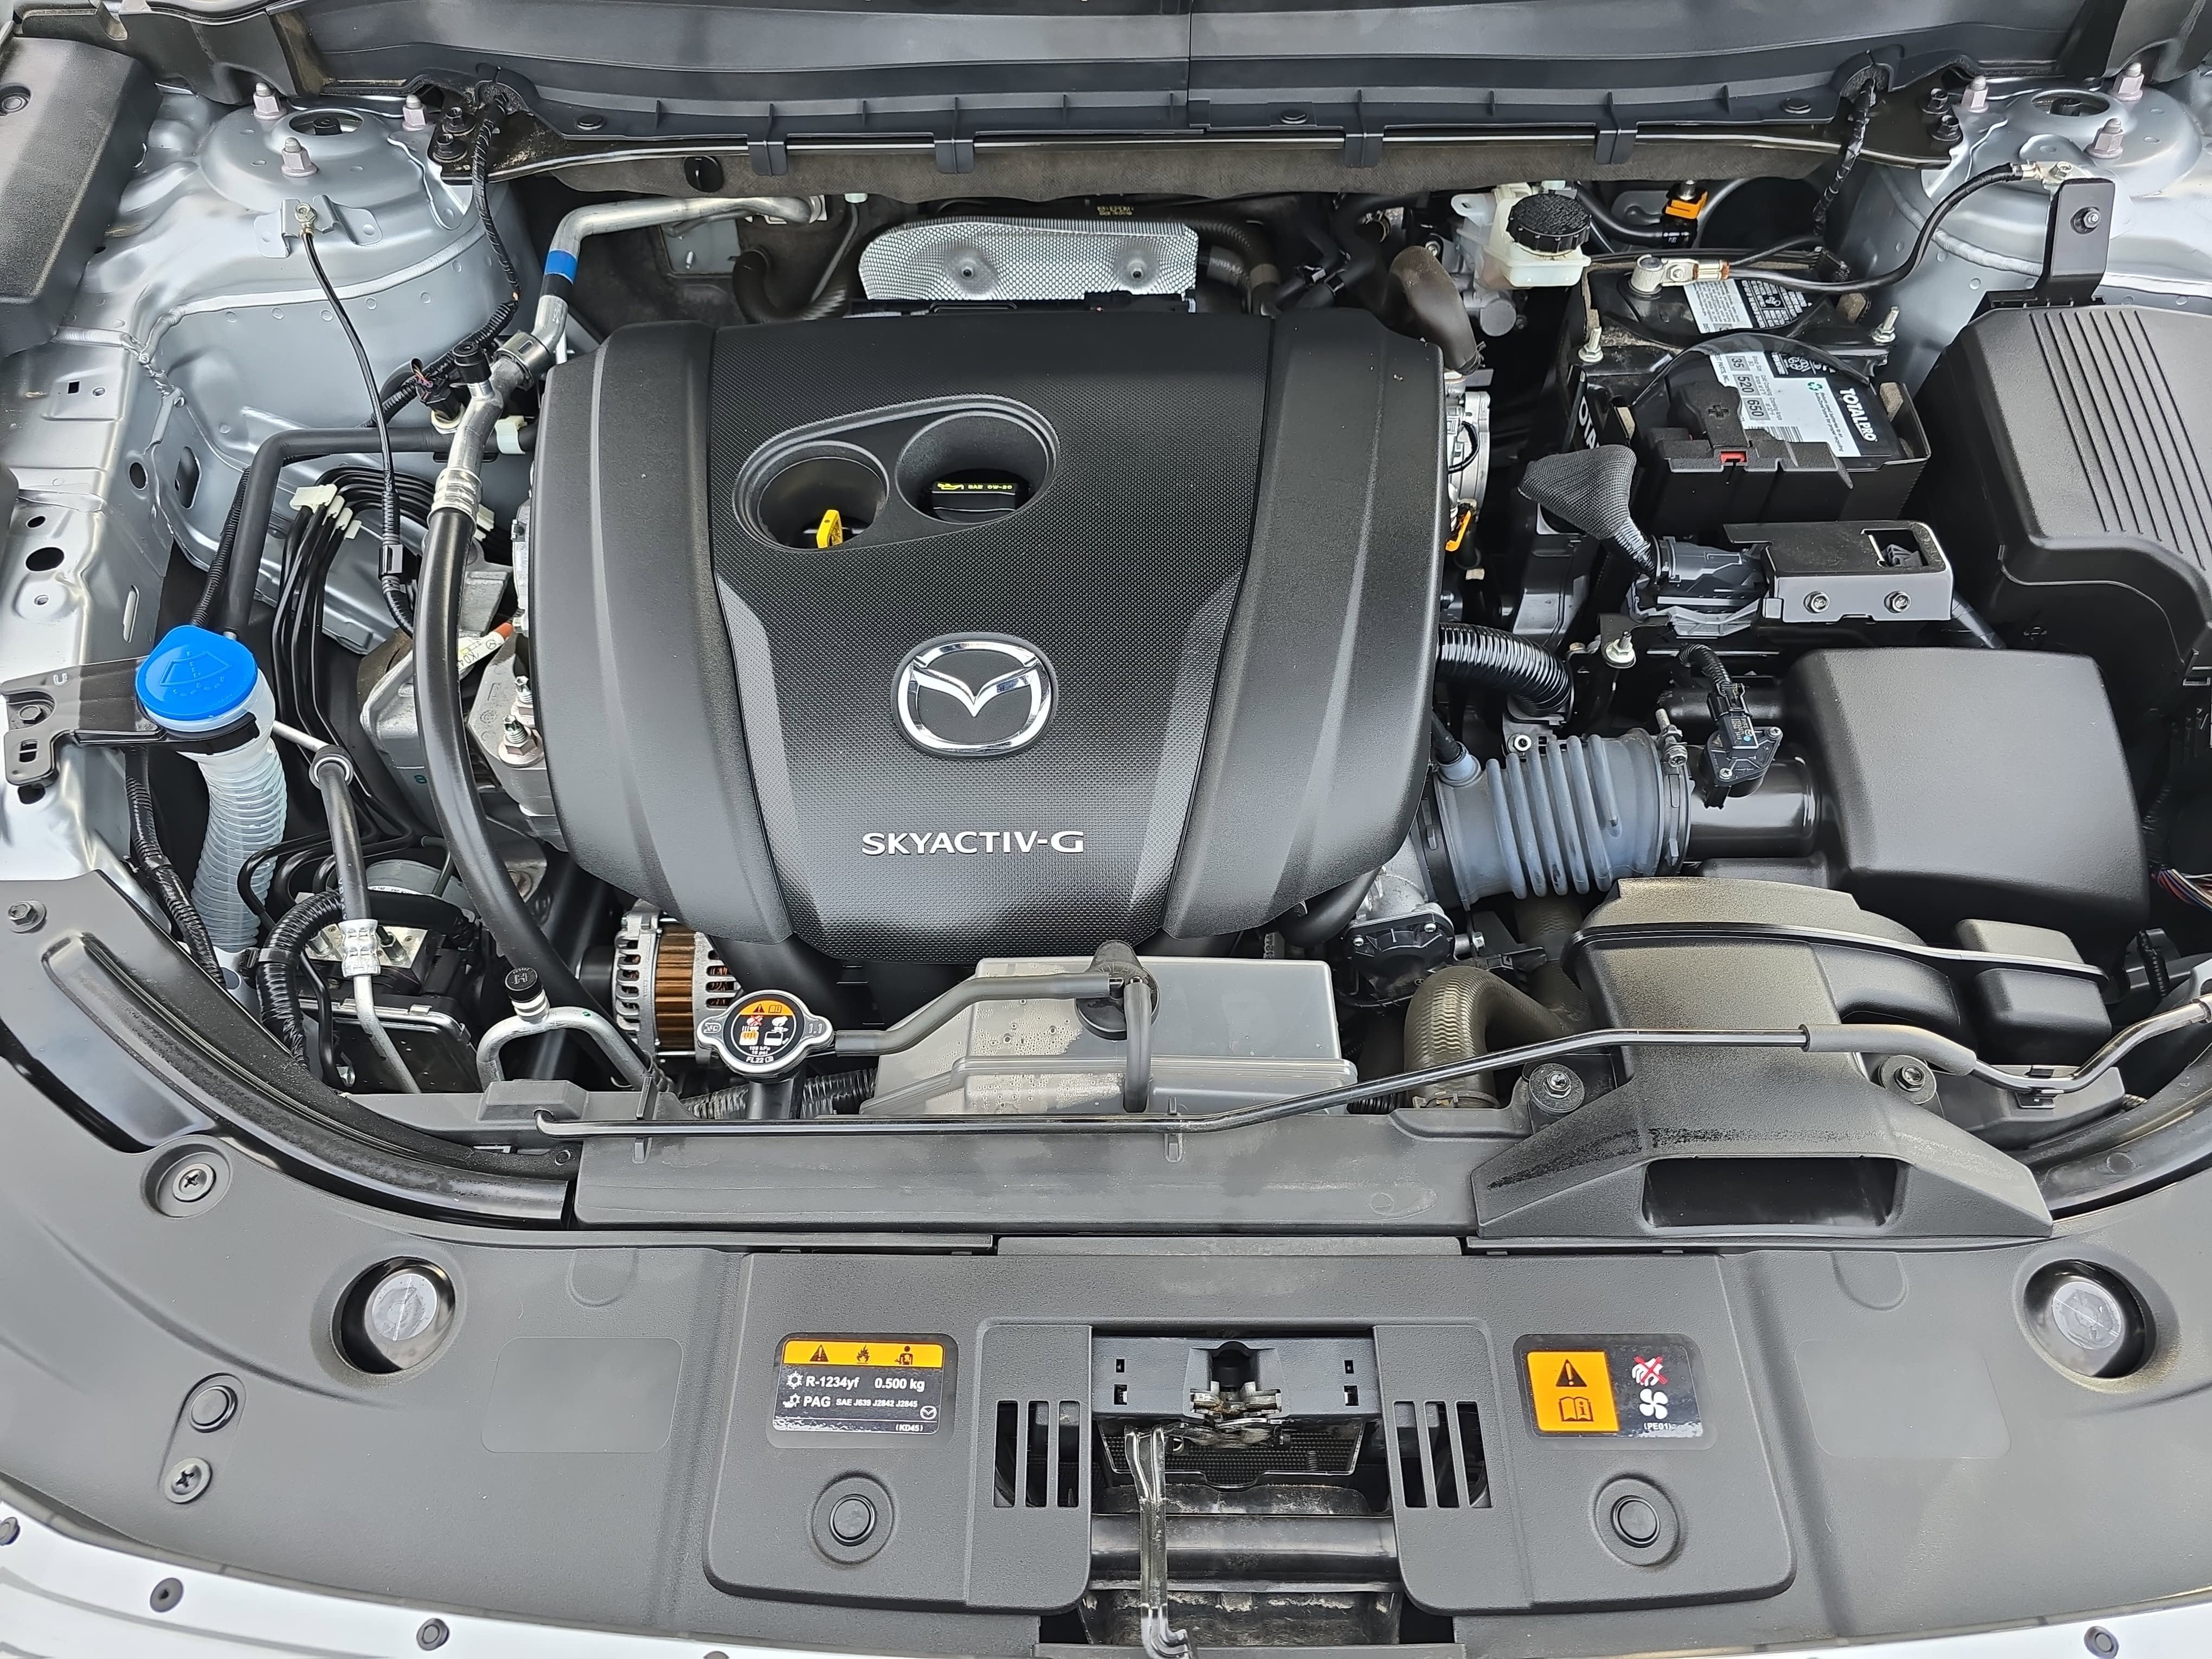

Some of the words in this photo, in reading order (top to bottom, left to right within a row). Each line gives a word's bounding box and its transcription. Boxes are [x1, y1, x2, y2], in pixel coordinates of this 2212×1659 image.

[1732, 358, 1745, 368] 35
[1737, 376, 1754, 393] 520
[1747, 400, 1764, 417] 650
[1840, 388, 1876, 441] TOTALPRO
[861, 831, 1084, 856] SKYACTIV-G
[809, 1024, 822, 1034] 1.1
[806, 1376, 860, 1390] R-1234yf
[874, 1378, 907, 1389] 0.500
[910, 1378, 925, 1392] kg
[803, 1396, 831, 1407] PAG
[896, 1400, 918, 1408] J2845
[896, 1424, 923, 1432] (KD45)
[1643, 1423, 1672, 1431] (PE01)
